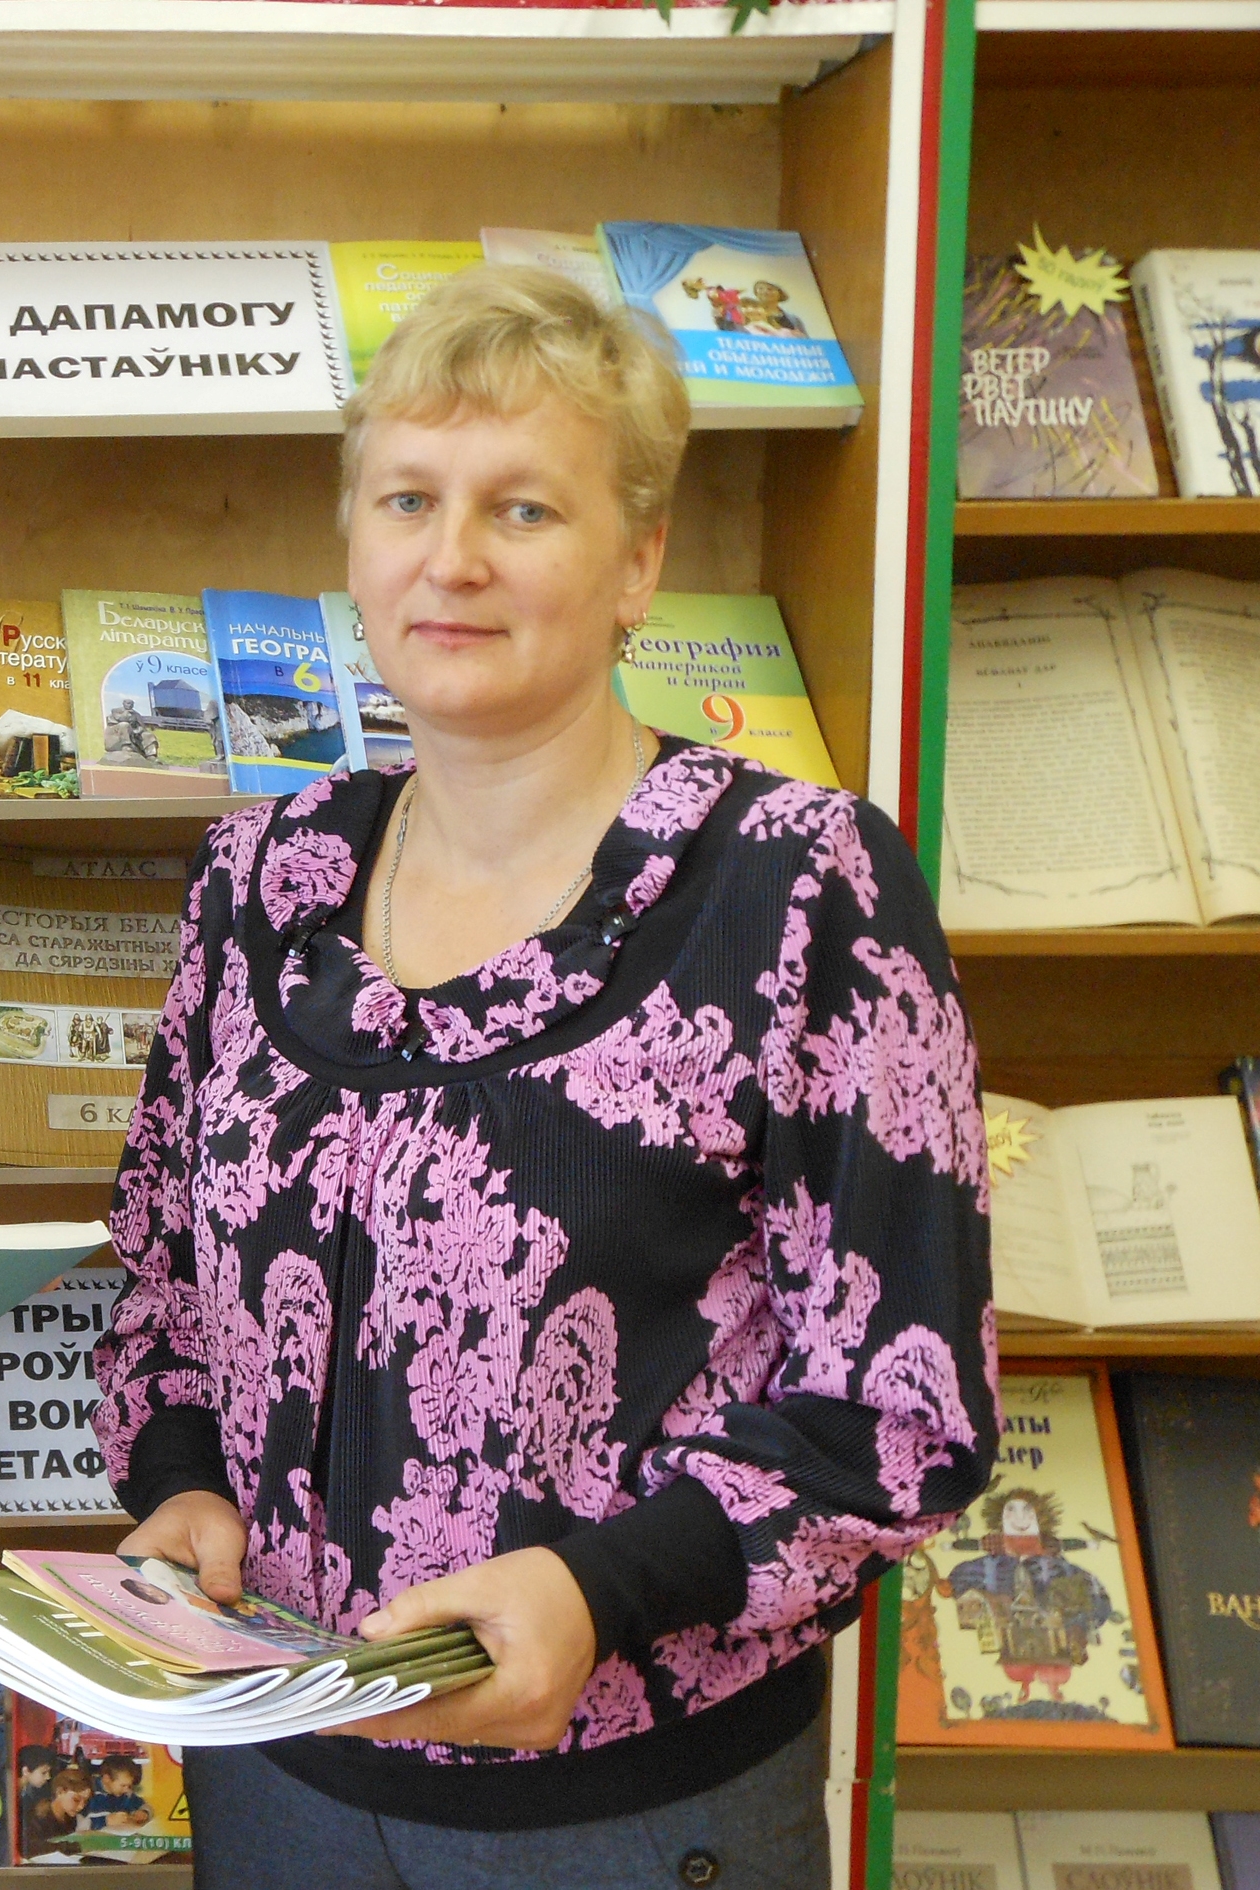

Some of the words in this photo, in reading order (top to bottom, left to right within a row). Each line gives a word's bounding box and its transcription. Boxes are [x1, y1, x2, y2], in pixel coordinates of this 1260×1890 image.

[9, 301, 296, 336] ДАПАМОГУ
[232, 638, 329, 663] ГЕОГРА
[147, 654, 162, 674] 9
[166, 665, 208, 676] класе
[23, 672, 41, 688] 11
[292, 662, 322, 693] 6
[666, 675, 678, 686] и
[683, 675, 747, 691] стран
[701, 693, 746, 744] 9
[748, 728, 794, 738] классе
[63, 861, 158, 877] АТЛАС
[28, 935, 174, 954] СТАРАЖЫТНЫХ
[15, 952, 42, 968] ДА
[48, 955, 155, 972] СЯРЭДЗІНЫ
[80, 1102, 98, 1123] 6
[8, 1303, 104, 1333] ТРЫ
